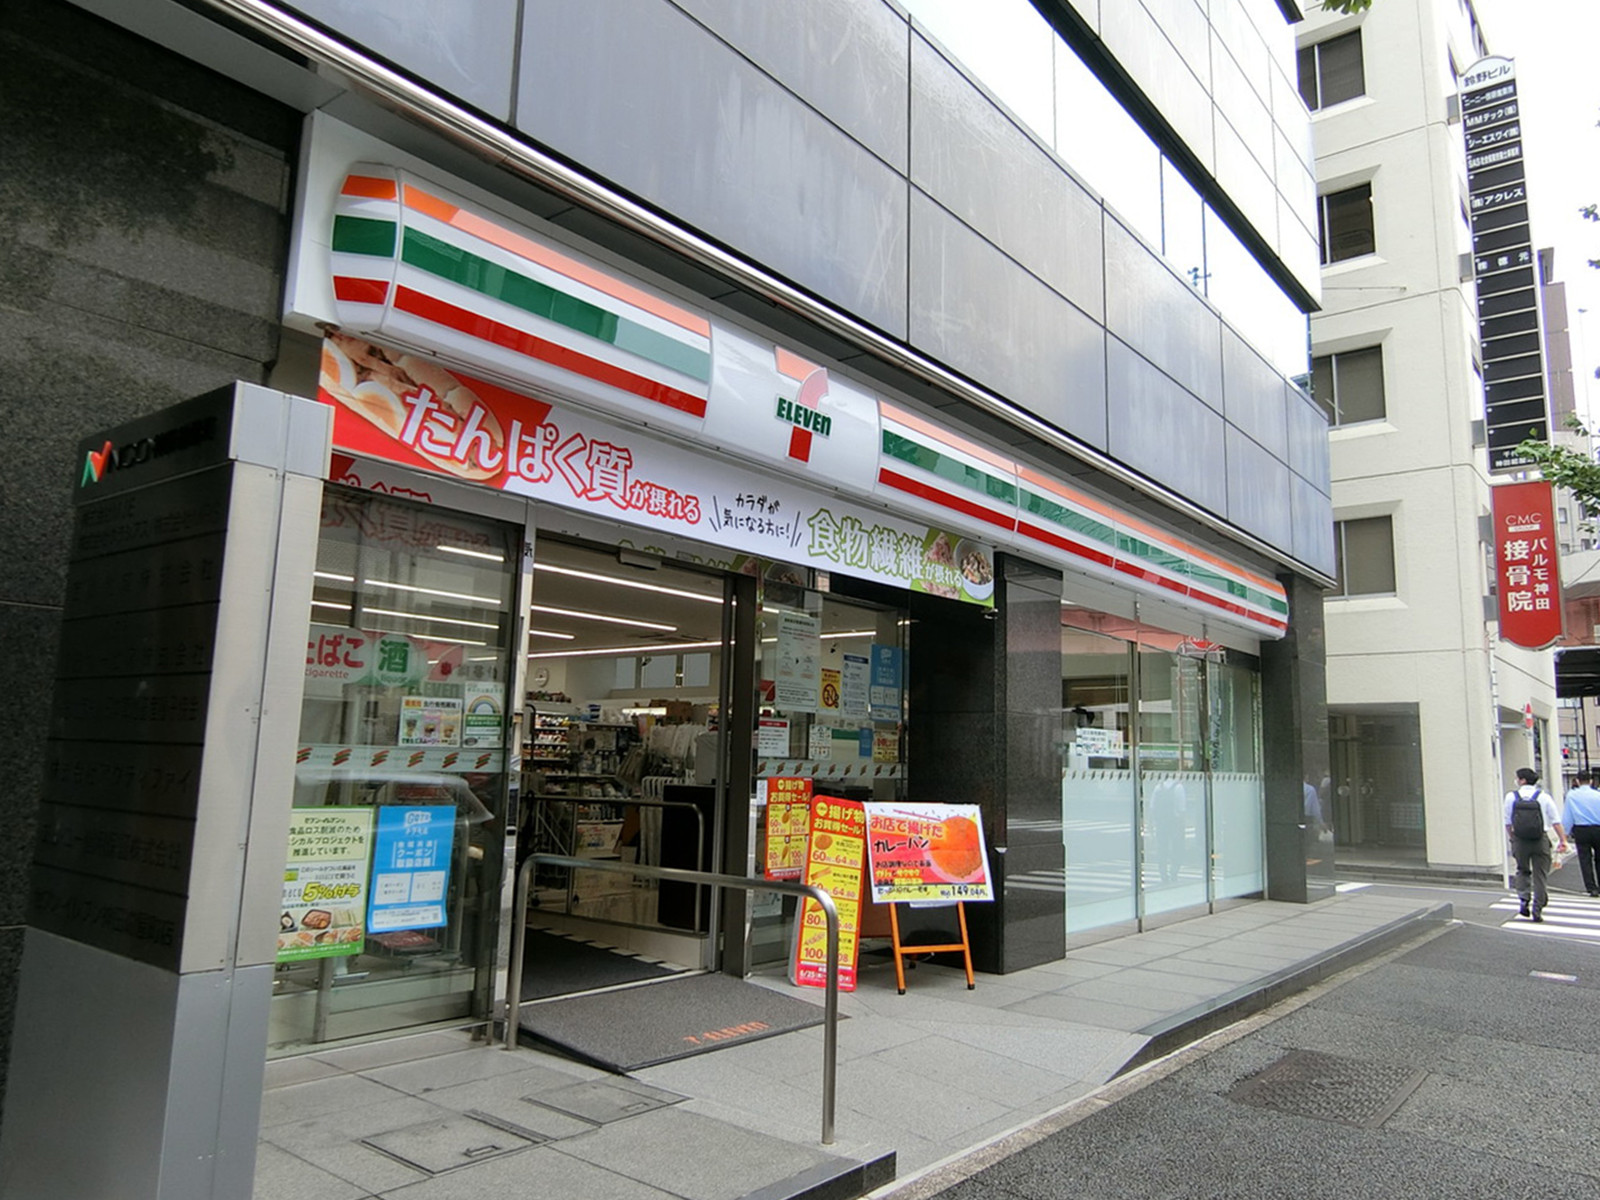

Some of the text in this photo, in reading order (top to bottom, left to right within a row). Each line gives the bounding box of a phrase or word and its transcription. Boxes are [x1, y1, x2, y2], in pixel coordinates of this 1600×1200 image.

[1505, 513, 1542, 525] CMC
[1504, 540, 1533, 612] 接骨院
[378, 639, 410, 673] 酒
